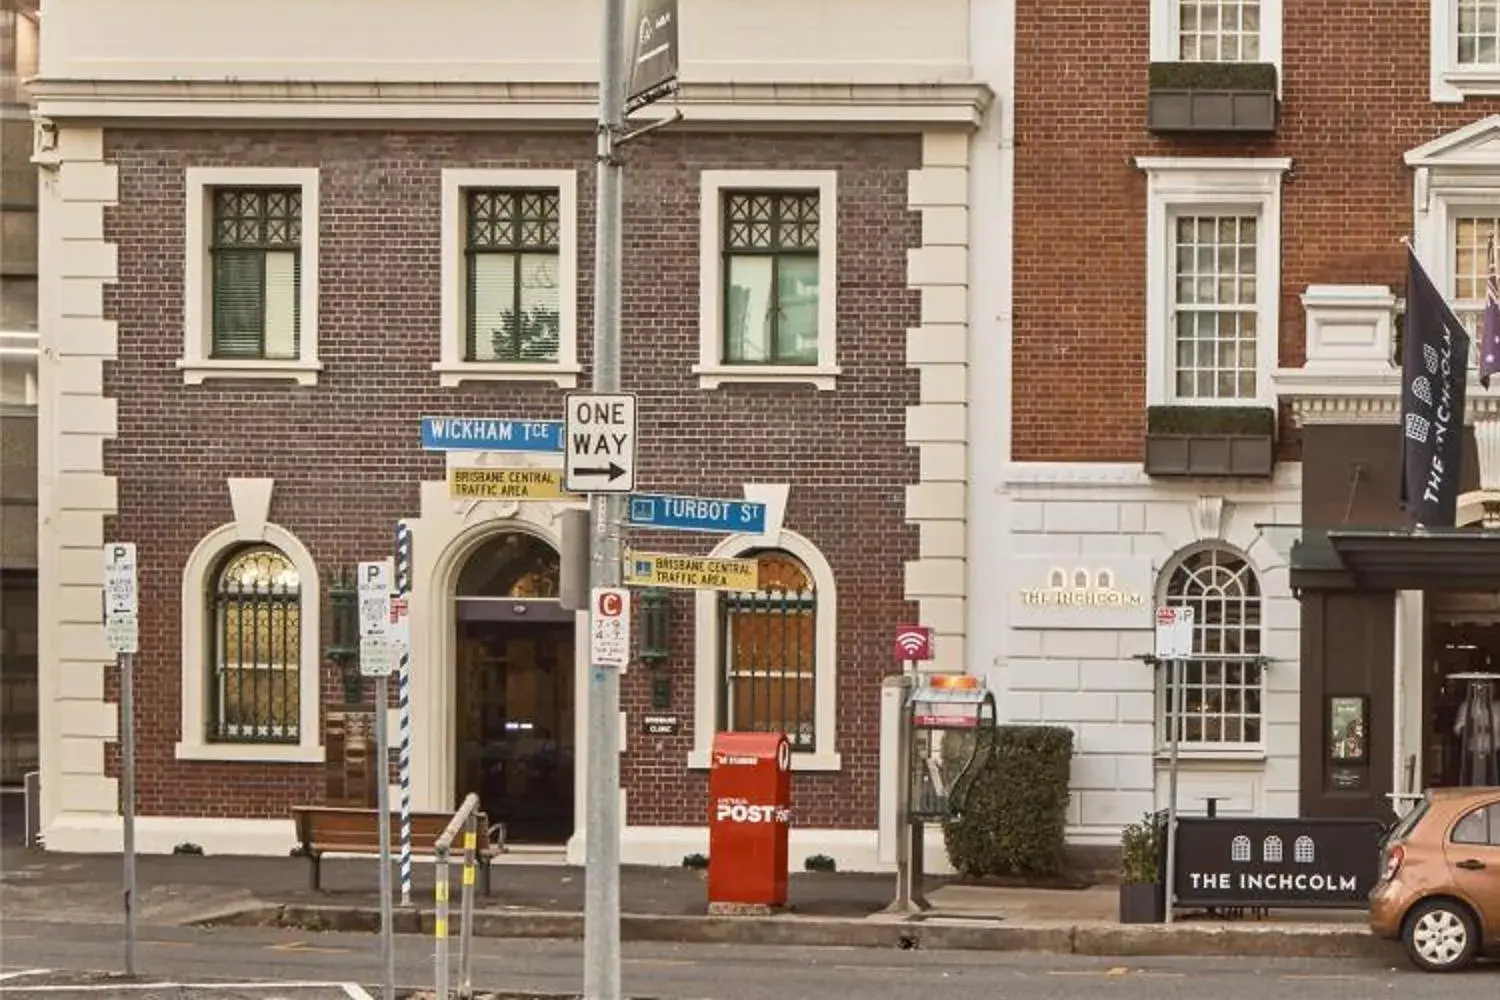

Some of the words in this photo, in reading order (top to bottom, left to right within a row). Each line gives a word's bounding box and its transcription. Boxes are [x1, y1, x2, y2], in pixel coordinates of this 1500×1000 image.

[577, 402, 625, 425] ONE
[431, 419, 513, 441] WICKHAM
[573, 433, 628, 455] WAY
[455, 471, 505, 483] BRISBANE
[509, 471, 554, 484] CENTRAL
[455, 484, 498, 496] TRAFFIC
[501, 485, 529, 497] AREA
[663, 499, 731, 521] TURBOT
[114, 546, 127, 562] P
[367, 565, 380, 582] P
[655, 557, 704, 573] BRISBANE
[709, 560, 752, 575] CENTRAL
[656, 571, 697, 585] TRAFFIC
[701, 573, 728, 585] AREA
[603, 594, 618, 615] C
[1021, 590, 1046, 605] THE
[716, 805, 775, 823] POST
[1190, 873, 1231, 889] THE
[1239, 873, 1357, 891] INCHCOLM
